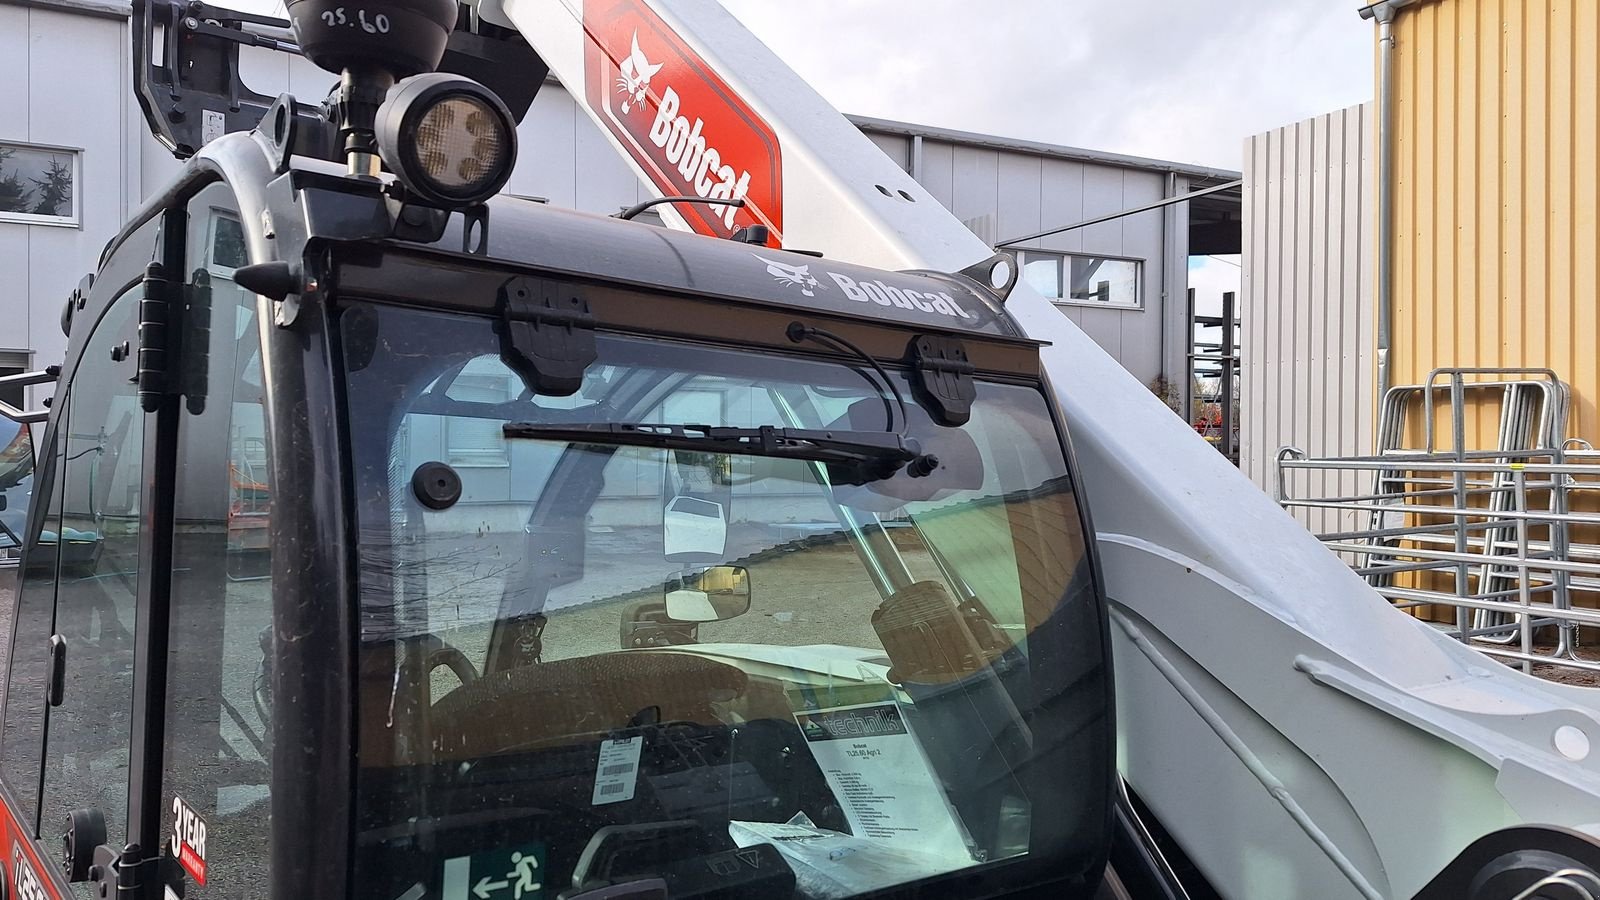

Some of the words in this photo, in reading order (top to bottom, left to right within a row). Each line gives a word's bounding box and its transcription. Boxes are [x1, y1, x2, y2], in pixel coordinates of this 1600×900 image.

[321, 7, 390, 34] 25.60
[648, 85, 751, 231] Bobcat
[826, 271, 970, 319] Bobcat
[824, 710, 899, 736] technik
[172, 797, 182, 858] 3
[182, 804, 206, 861] YEAR
[14, 849, 46, 900] TL25
